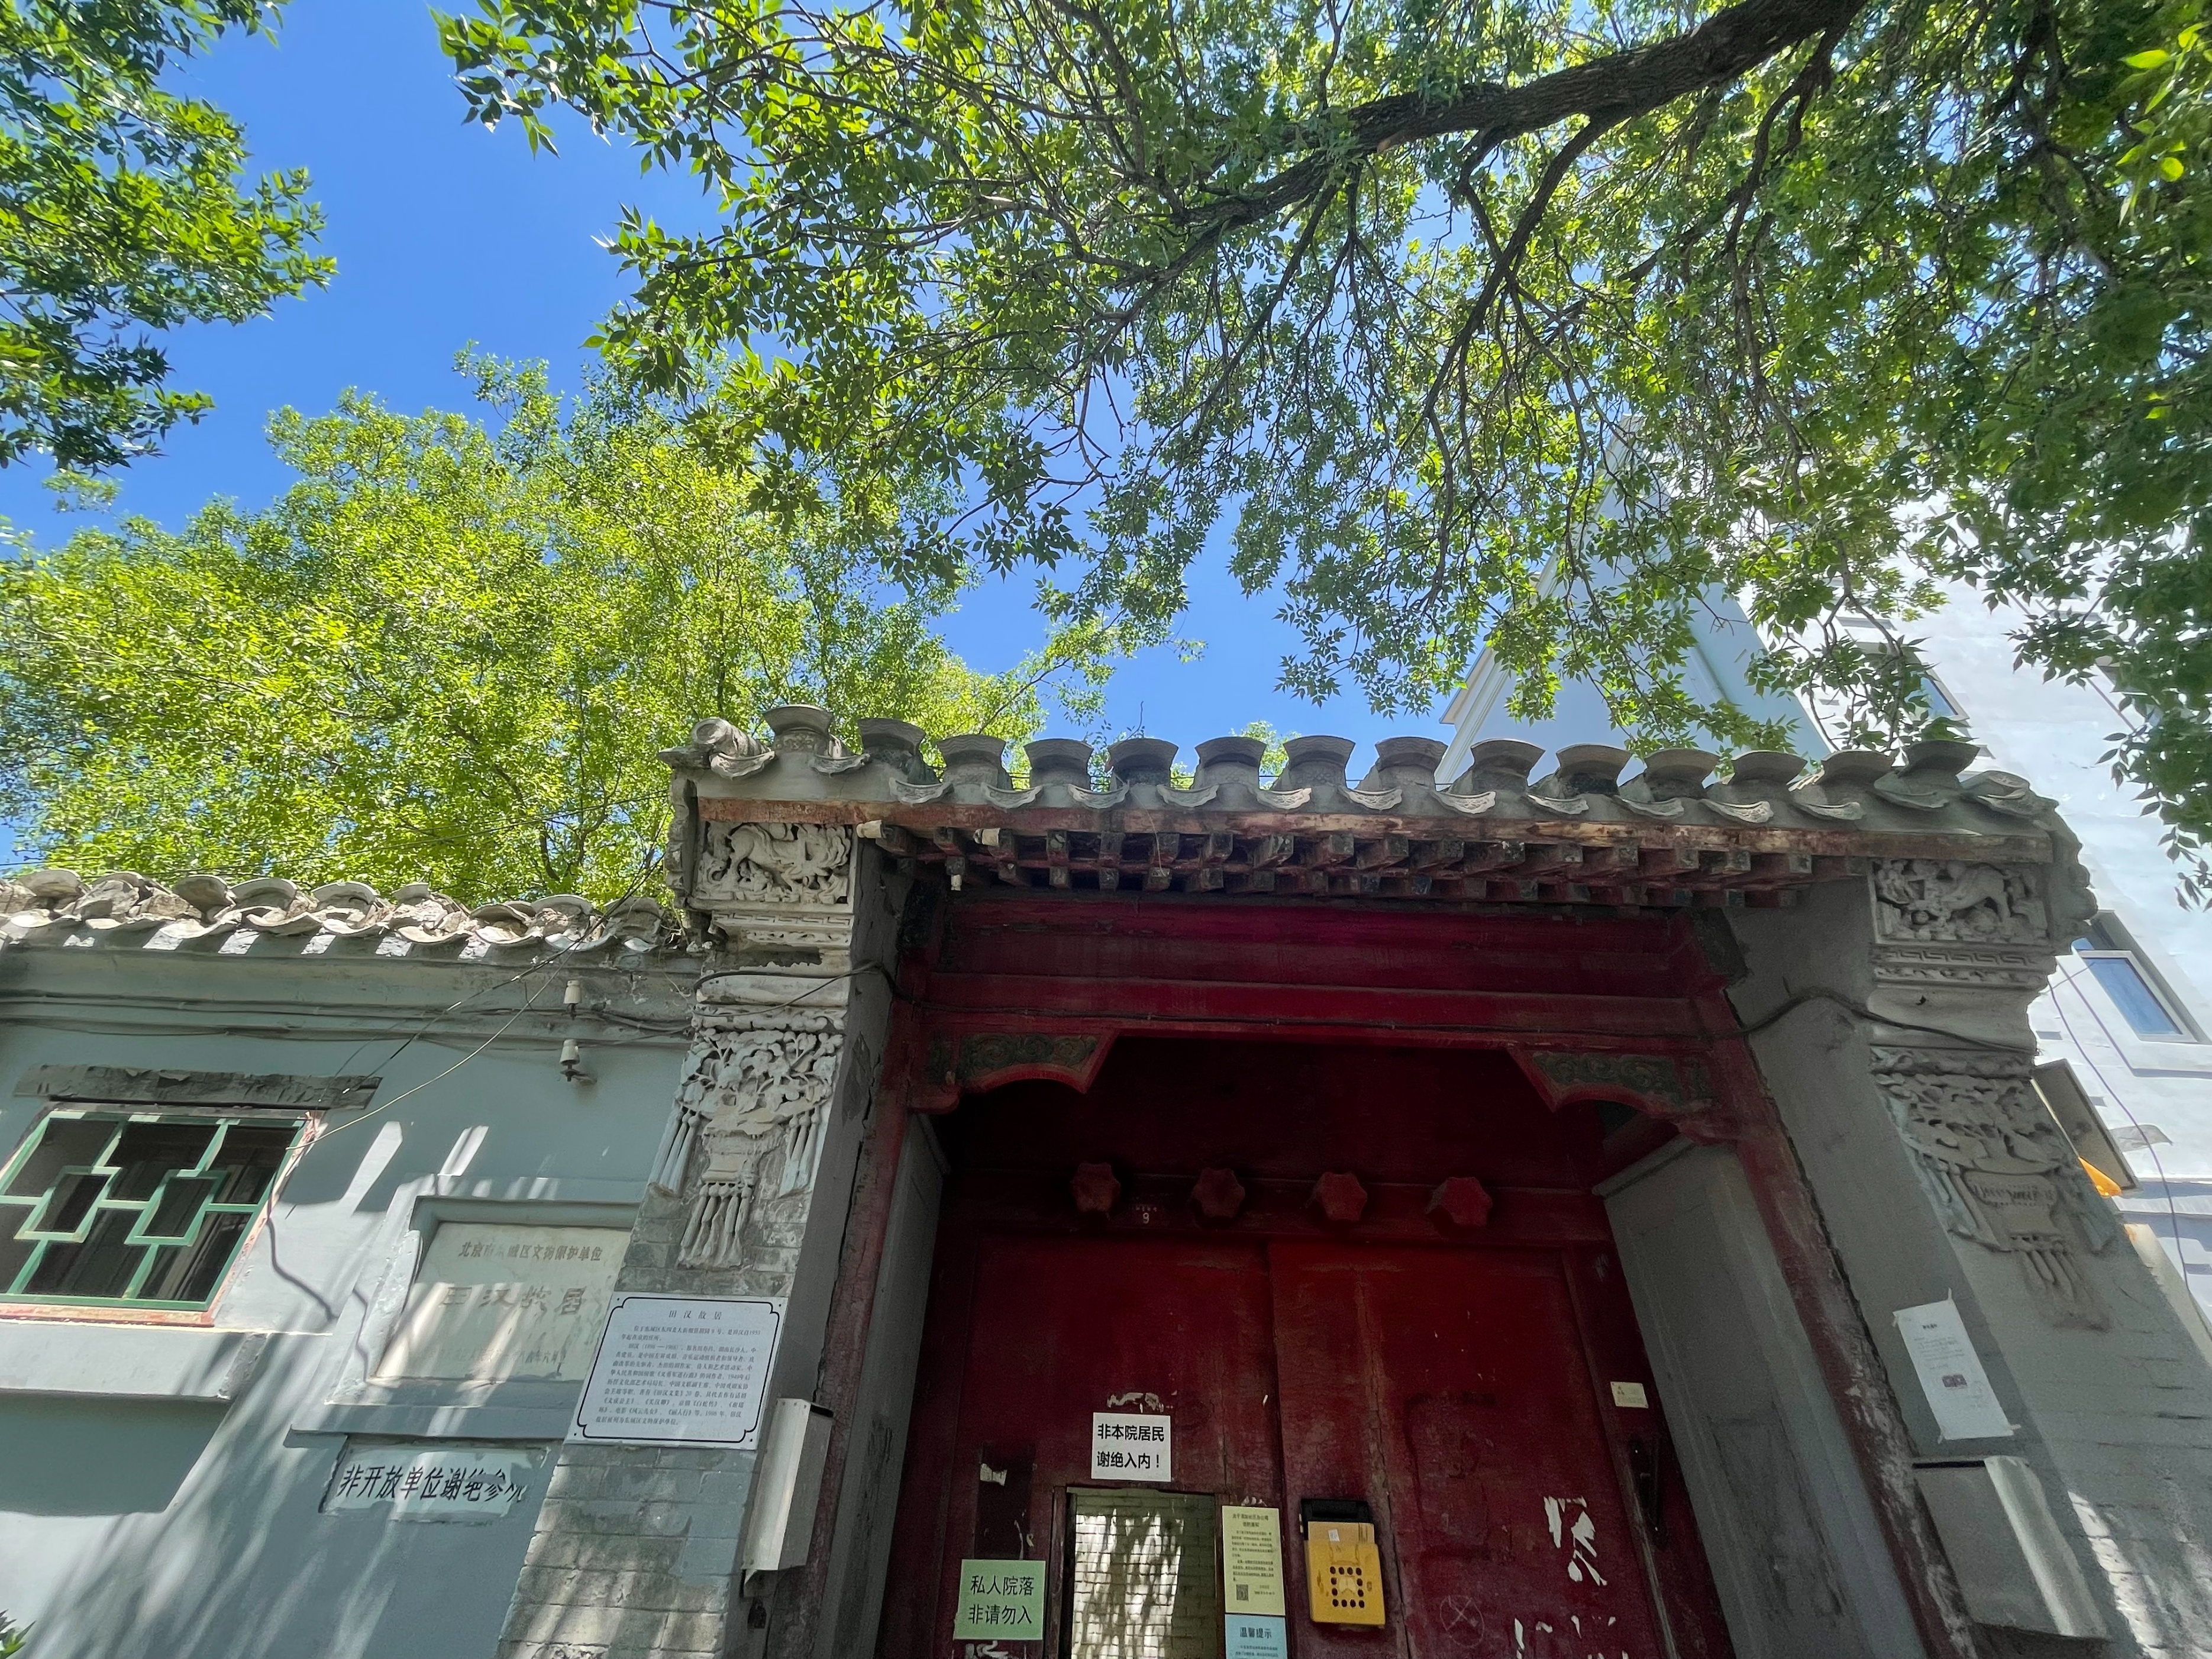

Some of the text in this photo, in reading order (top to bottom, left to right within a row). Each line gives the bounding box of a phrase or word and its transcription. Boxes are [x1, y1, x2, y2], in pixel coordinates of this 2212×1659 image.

[1143, 1212, 1149, 1224] 9
[669, 1309, 722, 1320] 田汉故居
[1097, 1424, 1164, 1442] 非本院居民
[1097, 1451, 1159, 1468] 谢绝入内！
[970, 1575, 1034, 1596] 私人院落
[968, 1604, 1032, 1625] 非请勿入
